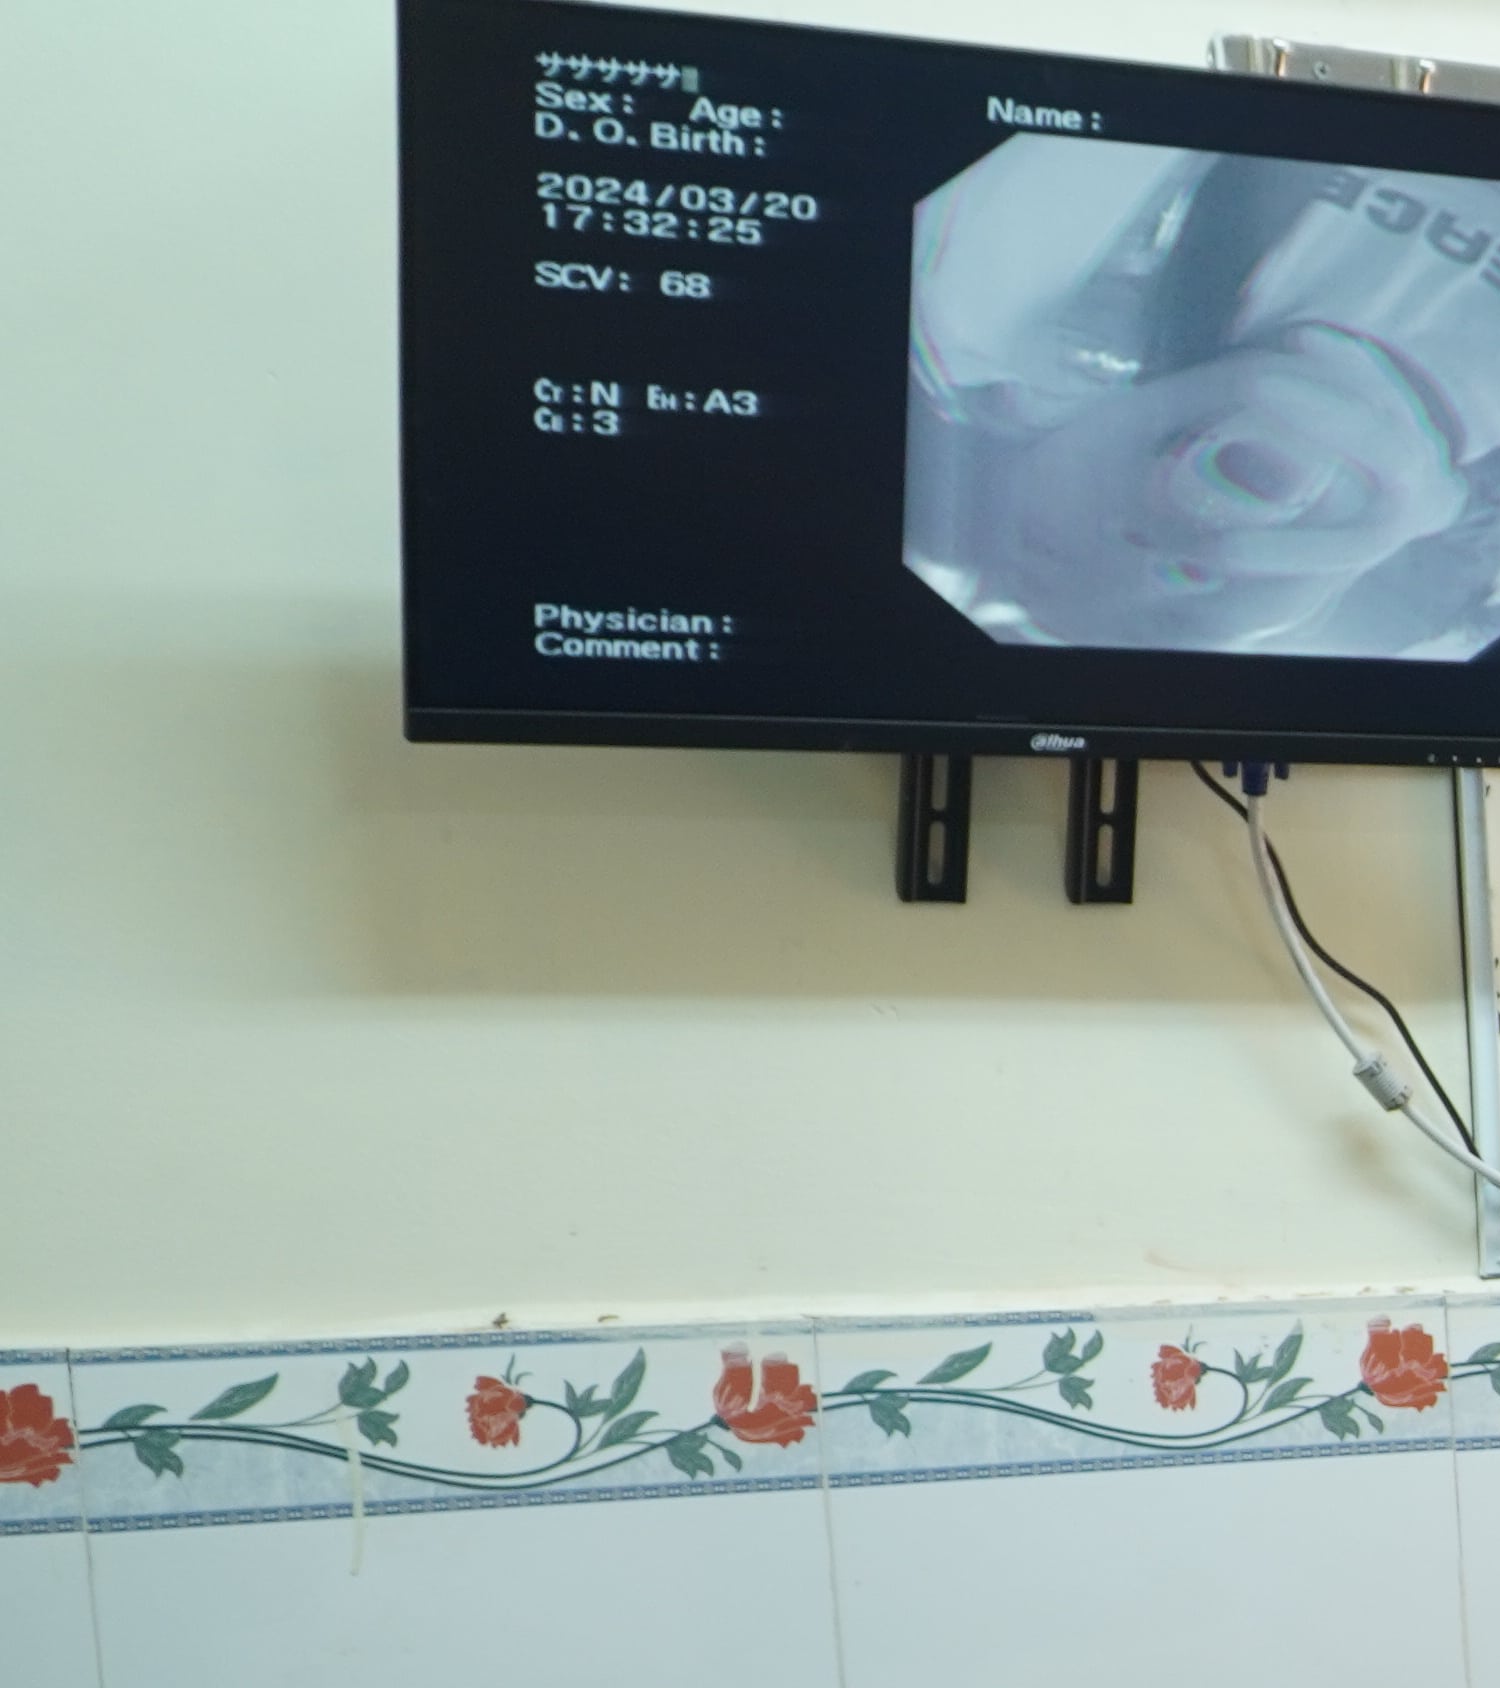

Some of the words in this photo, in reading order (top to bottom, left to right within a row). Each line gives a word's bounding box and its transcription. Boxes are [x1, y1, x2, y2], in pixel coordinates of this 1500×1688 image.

[534, 80, 634, 116] Sex:
[688, 96, 783, 130] Age:
[986, 95, 1102, 131] Name:
[536, 171, 820, 221] 2024/03/20
[541, 202, 764, 246] 17:32:25
[534, 261, 631, 292] SCV:
[659, 270, 713, 298] 68
[534, 603, 733, 634] Physician:
[534, 631, 719, 661] Comment:
